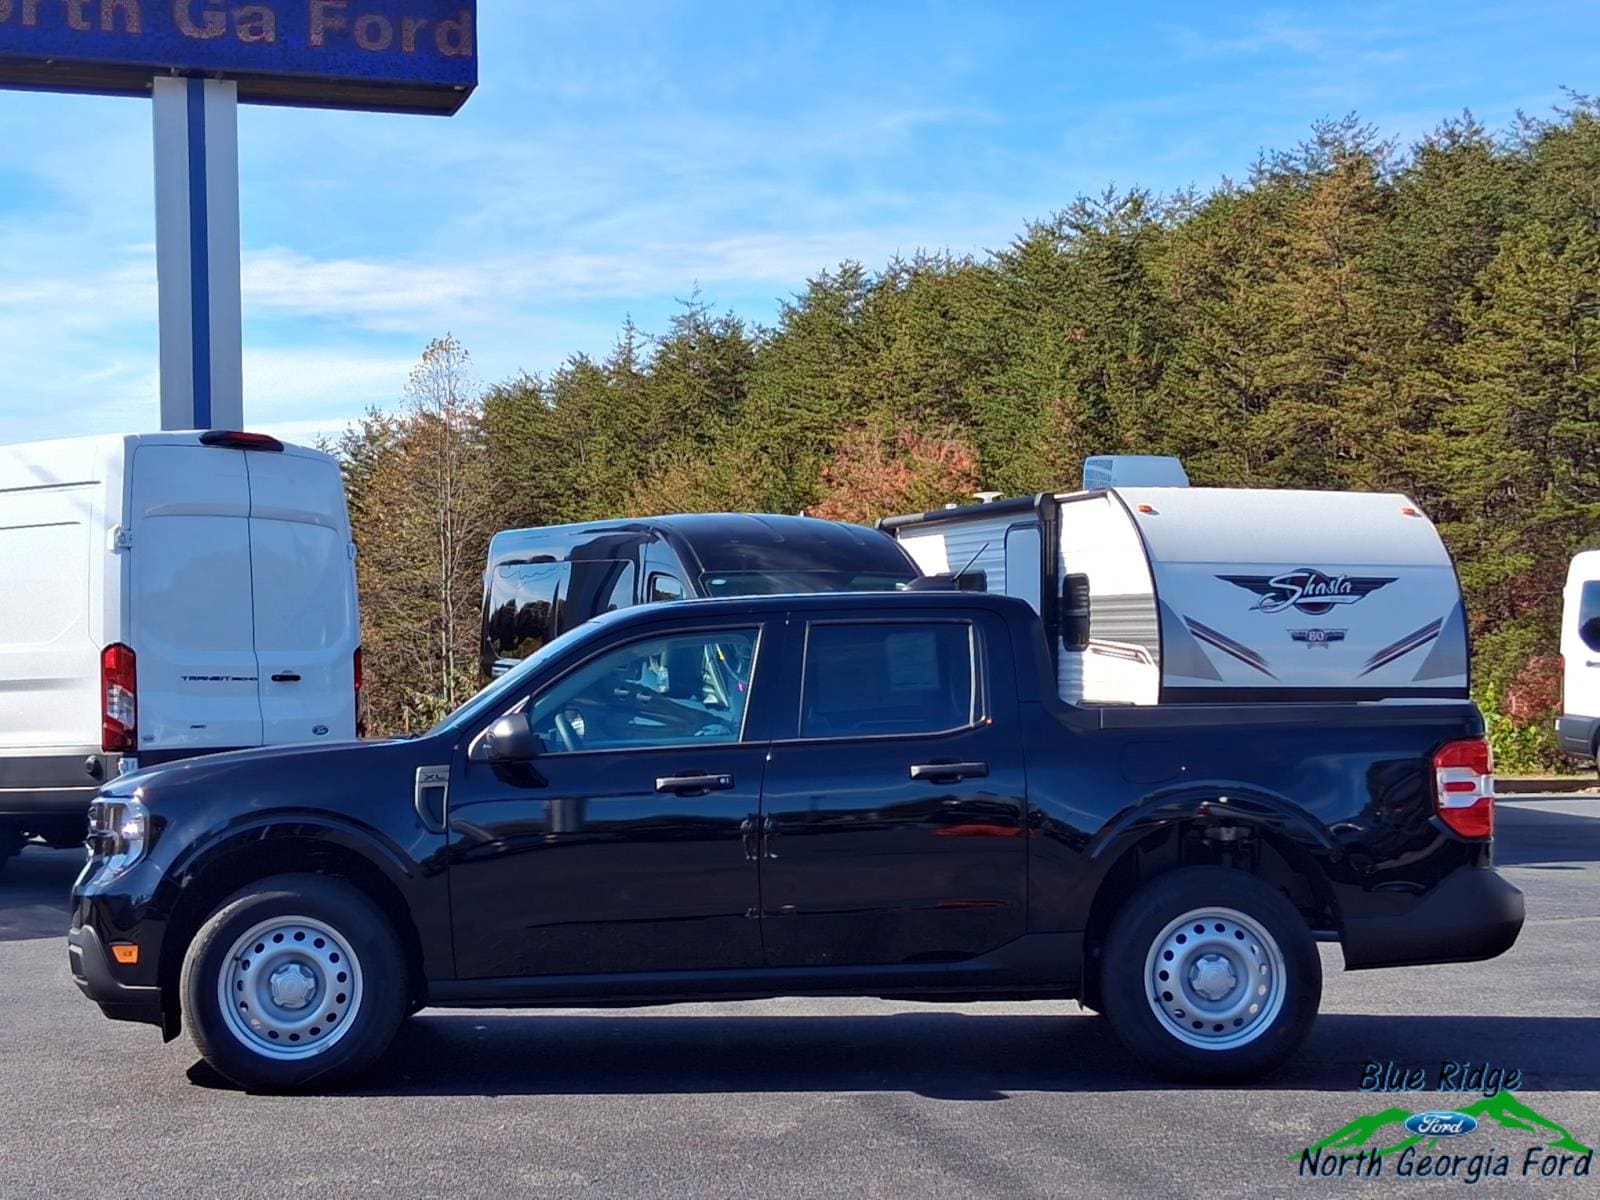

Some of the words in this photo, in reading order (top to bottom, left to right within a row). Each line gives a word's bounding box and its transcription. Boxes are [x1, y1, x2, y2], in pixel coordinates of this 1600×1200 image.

[176, 0, 277, 42] Ga
[309, 0, 473, 56] Ford
[1249, 572, 1353, 613] Shasta
[1308, 631, 1325, 642] 80
